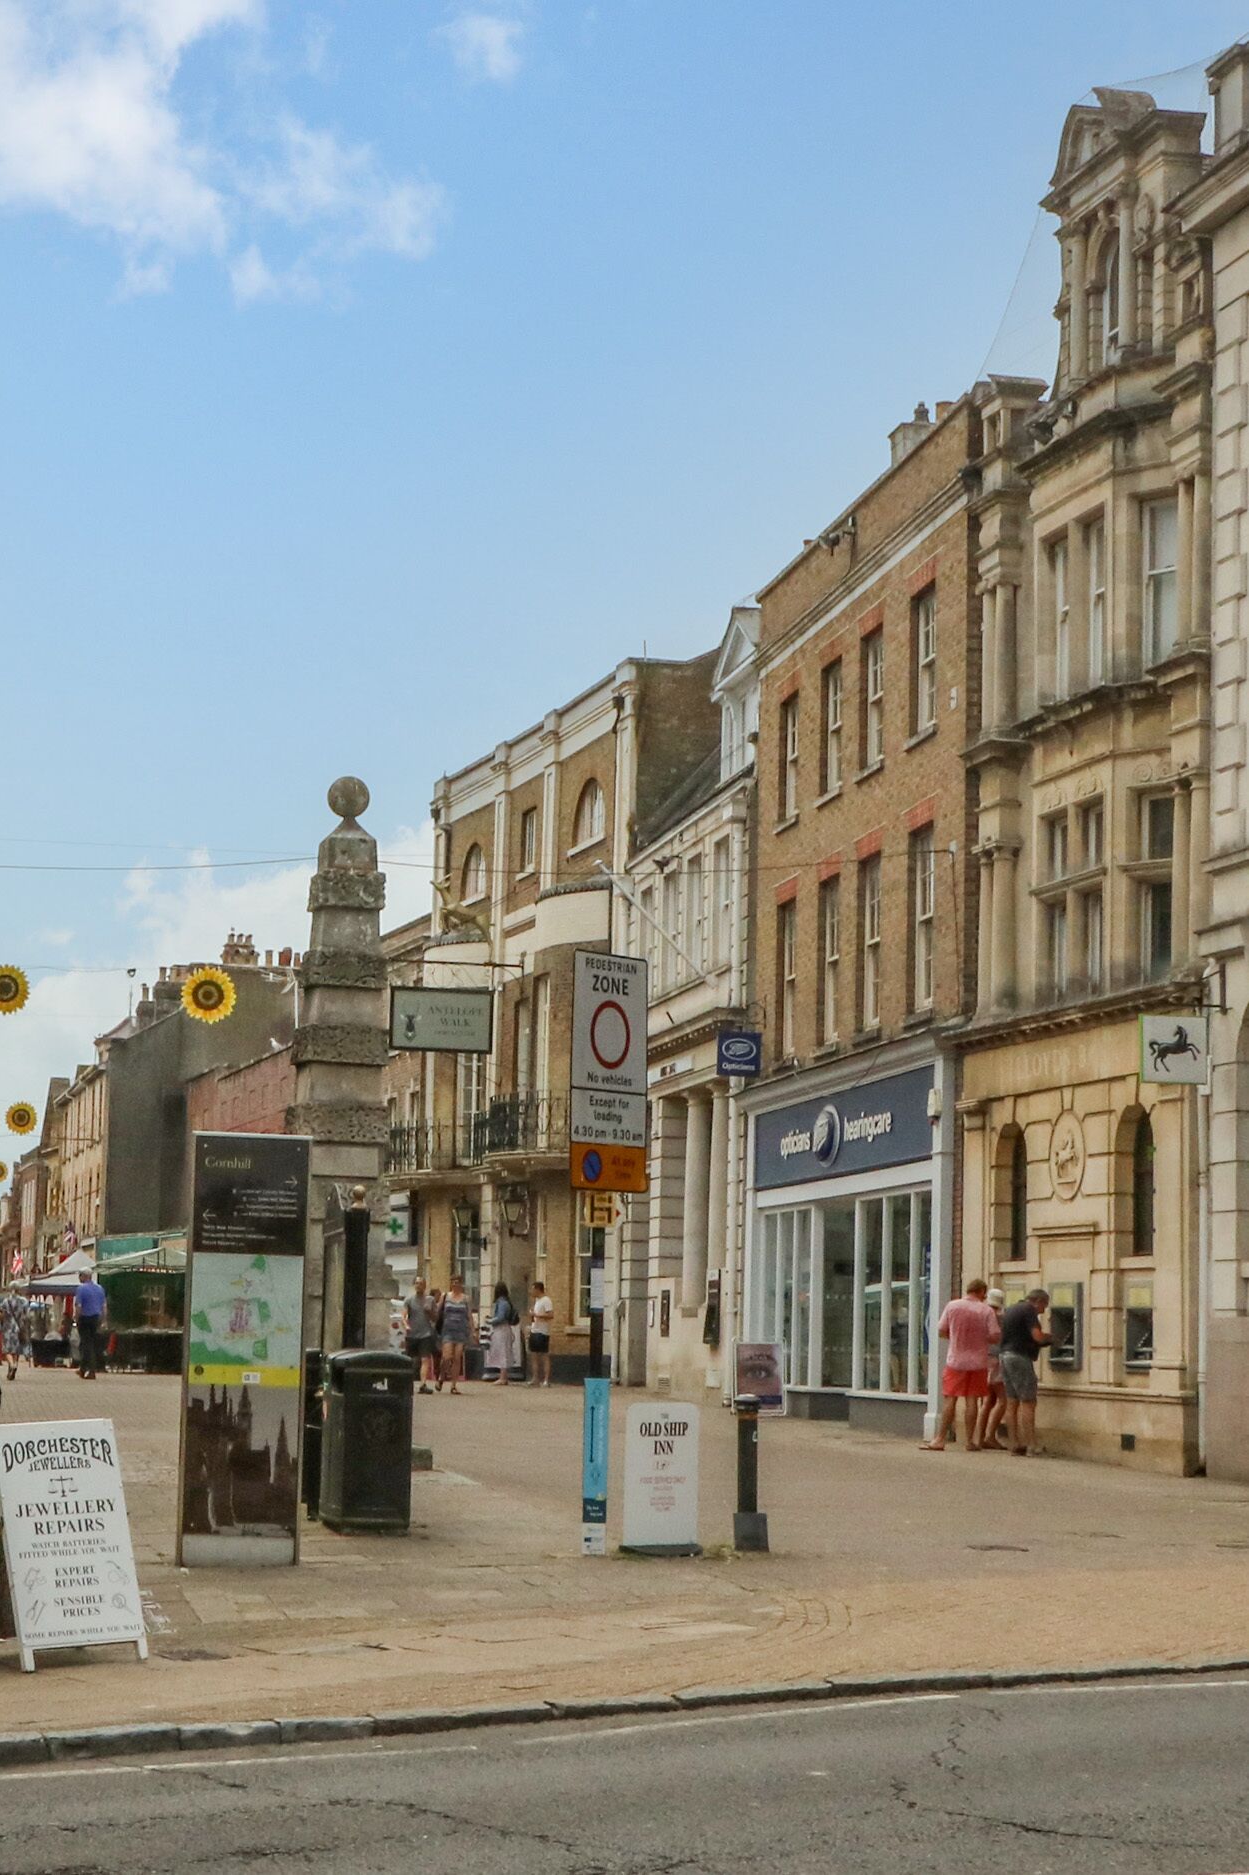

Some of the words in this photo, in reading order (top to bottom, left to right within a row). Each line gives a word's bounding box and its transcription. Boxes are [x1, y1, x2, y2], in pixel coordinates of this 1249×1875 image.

[585, 957, 638, 975] PEDESTRIAN
[592, 975, 630, 996] ZONE
[440, 1017, 471, 1027] WALK
[722, 1062, 755, 1071] Opticians
[587, 1072, 599, 1083] No
[601, 1074, 632, 1087] vehicles
[589, 1096, 616, 1110] Except
[618, 1098, 630, 1110] for
[593, 1110, 623, 1124] loading
[573, 1125, 594, 1138] 4.30
[595, 1129, 607, 1139] pm
[612, 1128, 631, 1141] 9.30
[632, 1133, 643, 1141] am
[780, 1129, 811, 1160] opticians
[843, 1110, 893, 1142] hearingcare
[204, 1156, 252, 1169] Cornhill
[639, 1422, 662, 1437] OLD
[663, 1421, 689, 1437] SHIP
[2, 1437, 114, 1473] DORCHESTER
[654, 1440, 675, 1455] INN
[28, 1455, 92, 1472] JEWELLERS
[15, 1499, 116, 1518] JEWELLERY
[34, 1518, 105, 1535] REPAIRS
[31, 1540, 60, 1549] WATCH
[63, 1538, 106, 1547] BATTERIES
[18, 1551, 48, 1560] FITTED
[51, 1549, 77, 1557] WHILE
[81, 1547, 96, 1555] YOU
[100, 1545, 120, 1554] WAIT
[55, 1565, 95, 1577] EXPERT
[54, 1577, 100, 1589] REPAIRS
[53, 1594, 107, 1607] SENSIBLE
[62, 1607, 102, 1618] PRICES
[48, 1630, 78, 1638] REPAIRS
[80, 1627, 104, 1635] WHILE
[107, 1625, 120, 1633] YOU
